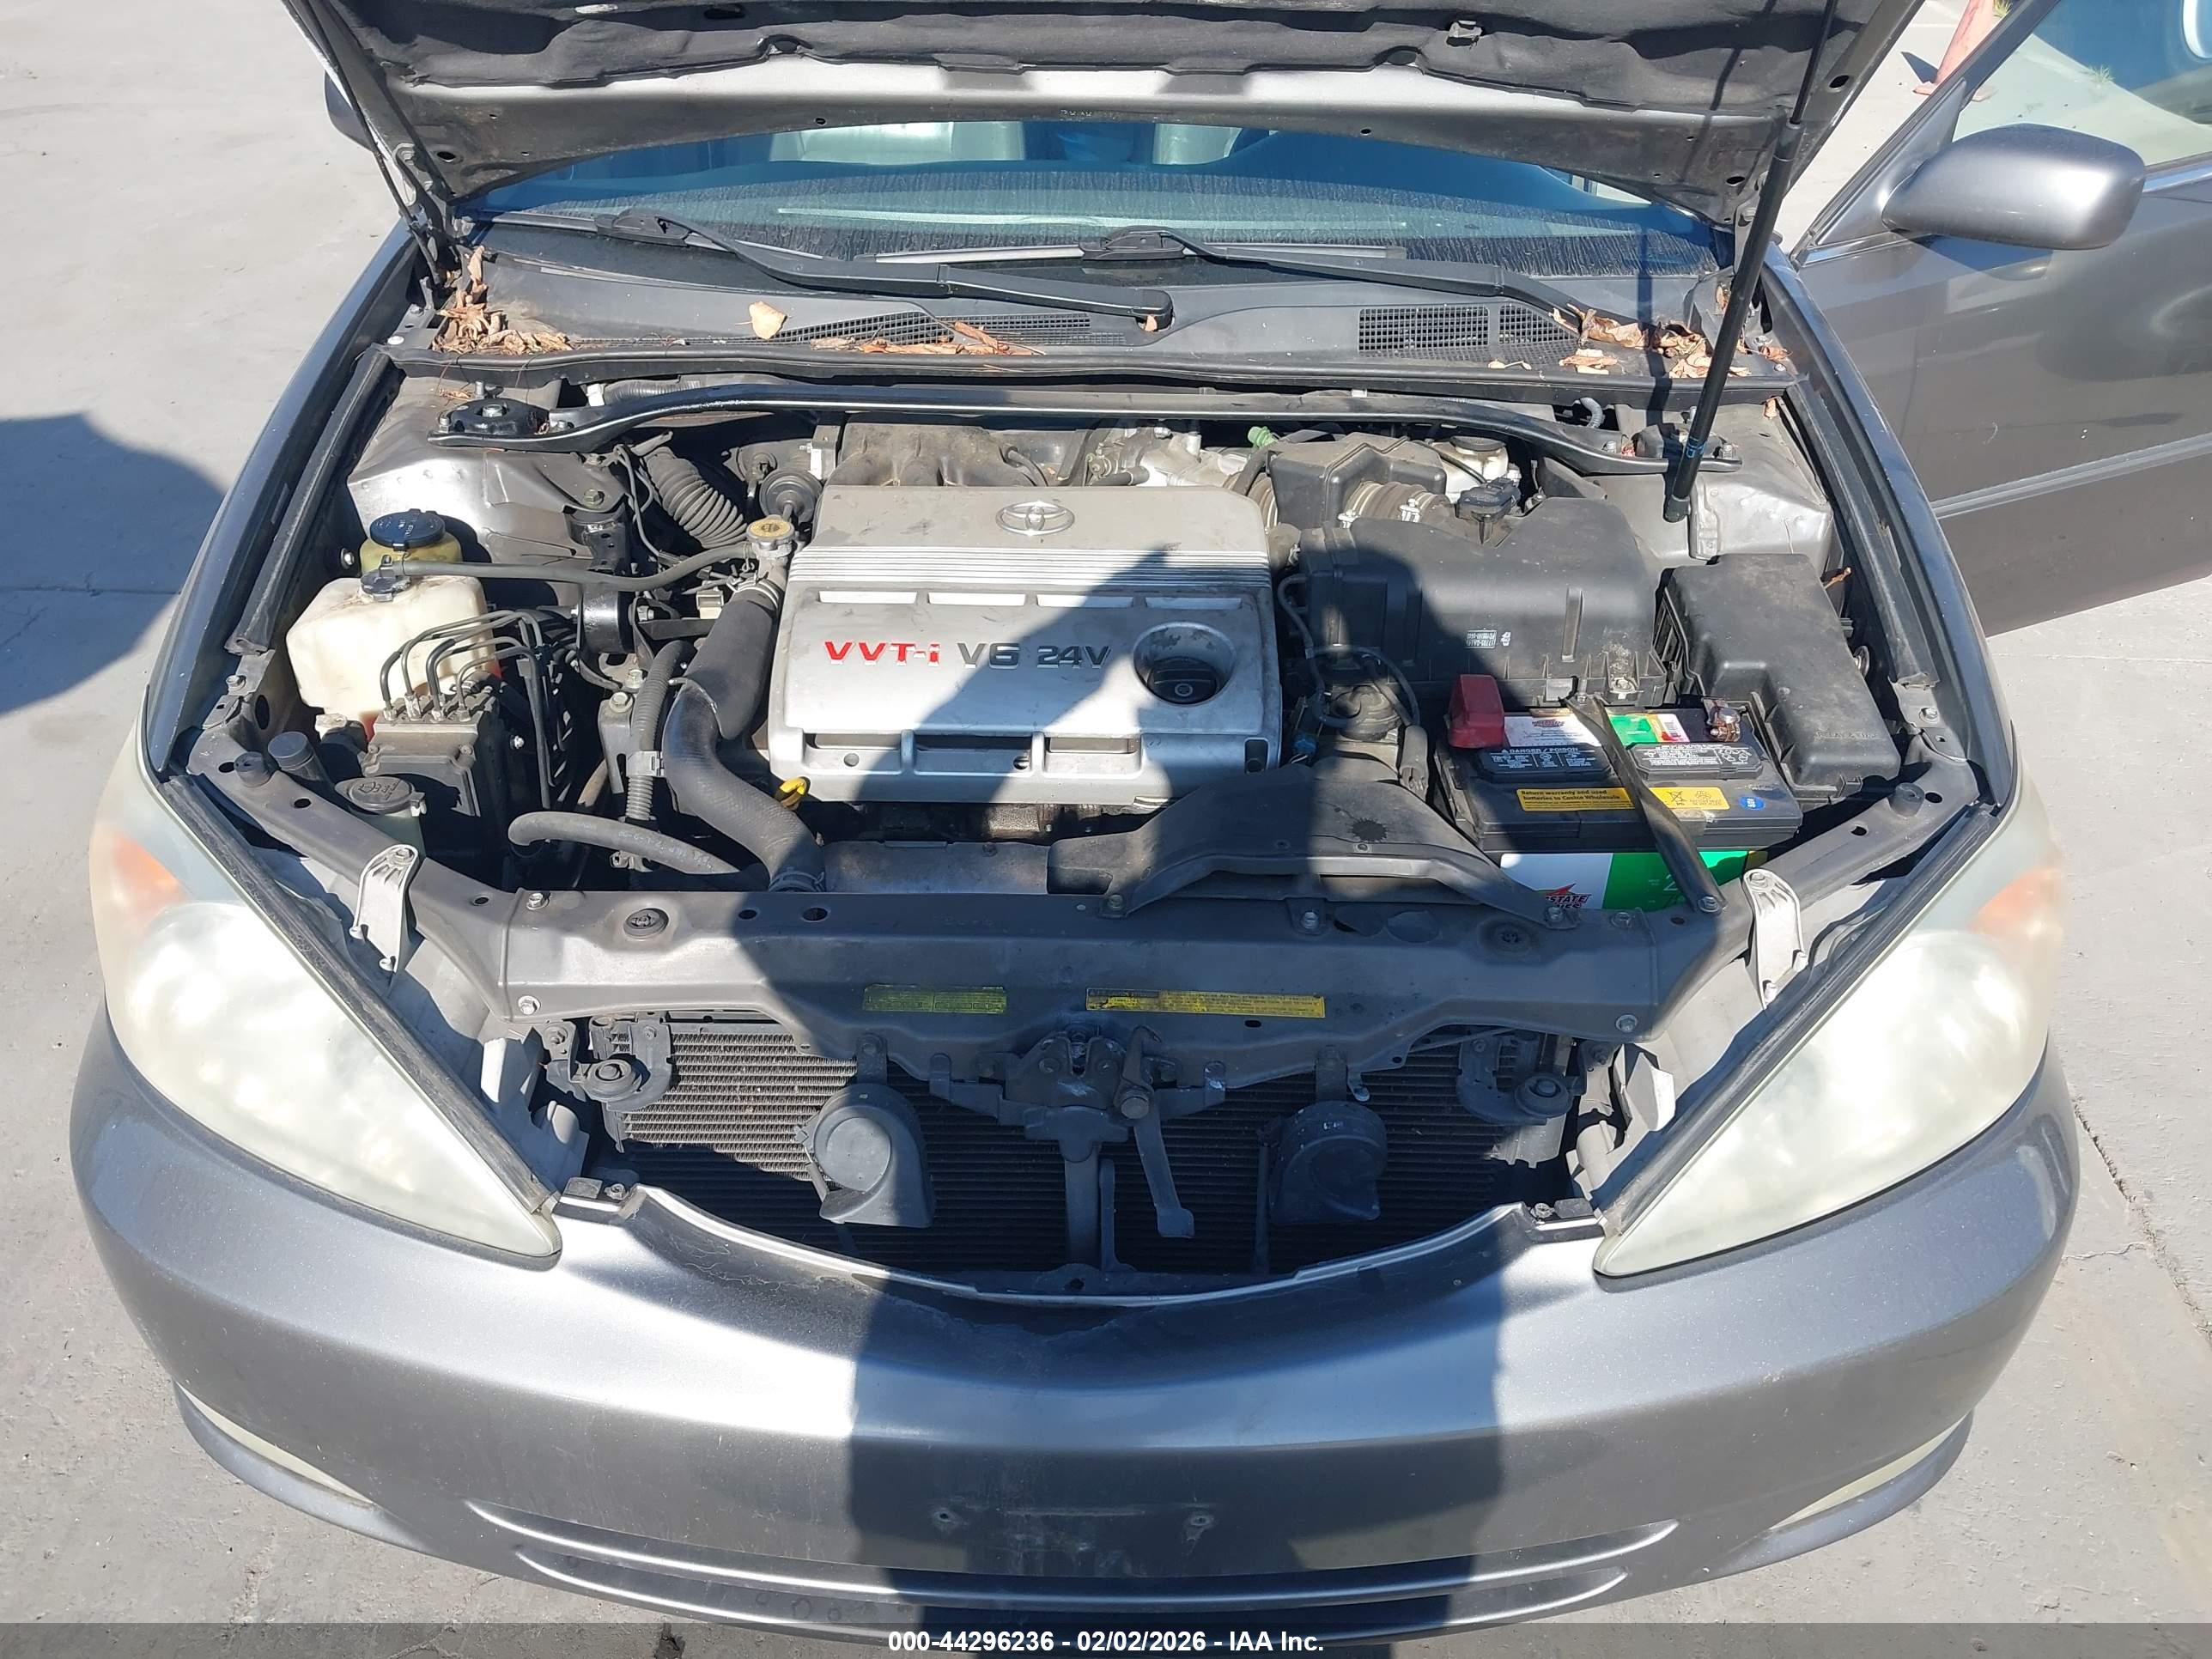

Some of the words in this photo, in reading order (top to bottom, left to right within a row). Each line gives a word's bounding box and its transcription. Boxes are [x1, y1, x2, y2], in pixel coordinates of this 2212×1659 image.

[824, 641, 940, 666] VVT-i
[957, 642, 1020, 669] V6
[1036, 646, 1110, 669] 24V
